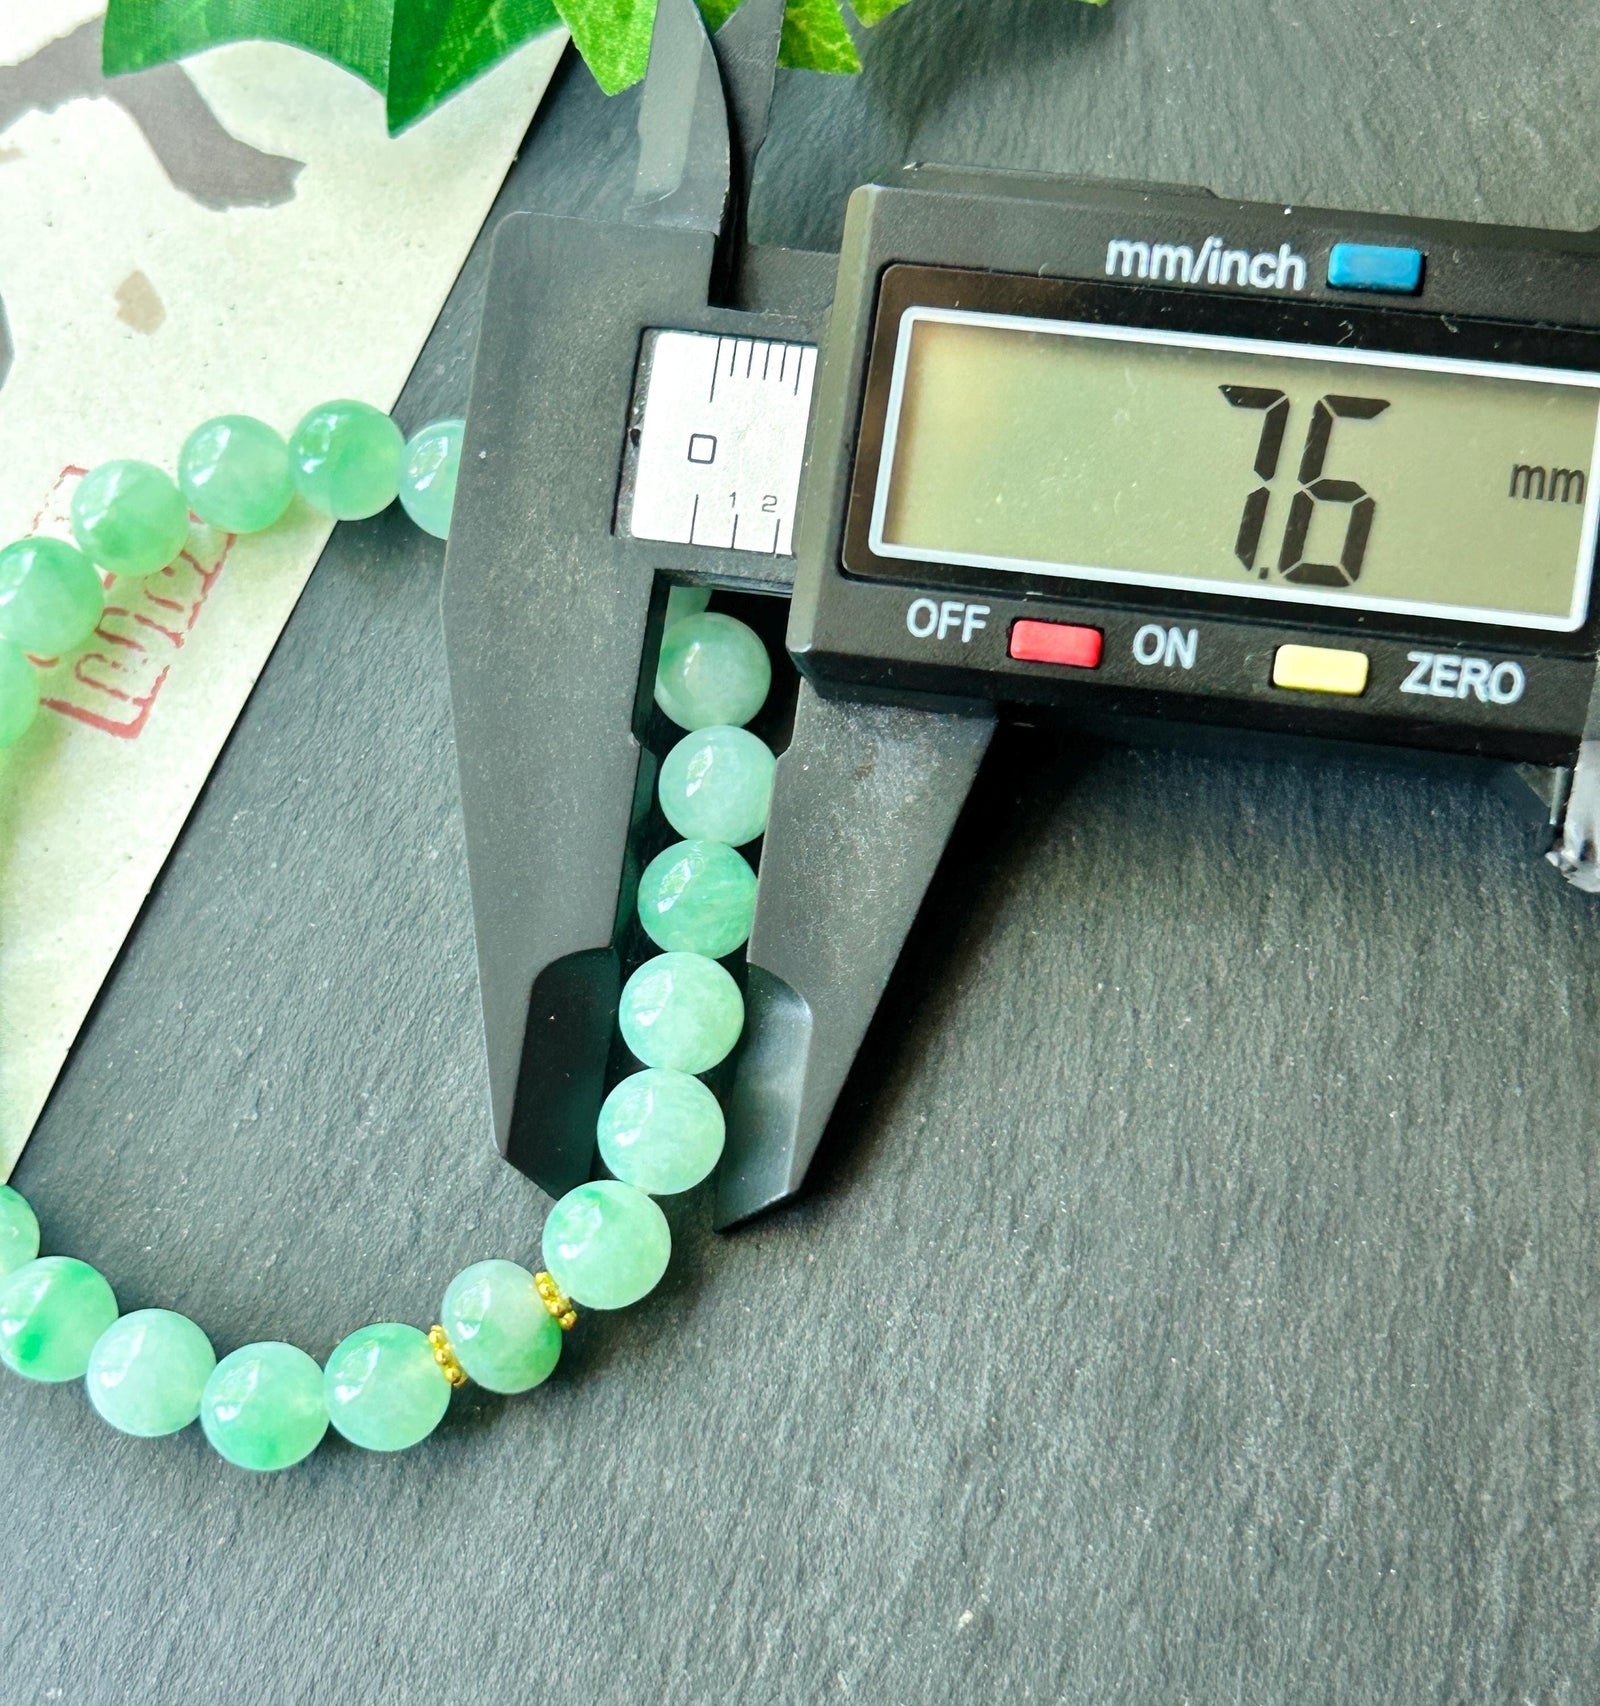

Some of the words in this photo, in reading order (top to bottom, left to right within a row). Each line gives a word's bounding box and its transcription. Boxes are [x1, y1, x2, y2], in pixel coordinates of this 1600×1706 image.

[1105, 237, 1307, 291] mm/inch
[688, 433, 717, 464] 0
[729, 491, 736, 508] 1
[761, 494, 778, 513] 2
[1218, 384, 1392, 587] 7.6
[1508, 461, 1585, 505] mm
[906, 598, 990, 644] OFF
[1132, 624, 1200, 670] ON
[1400, 651, 1526, 704] ZERO
